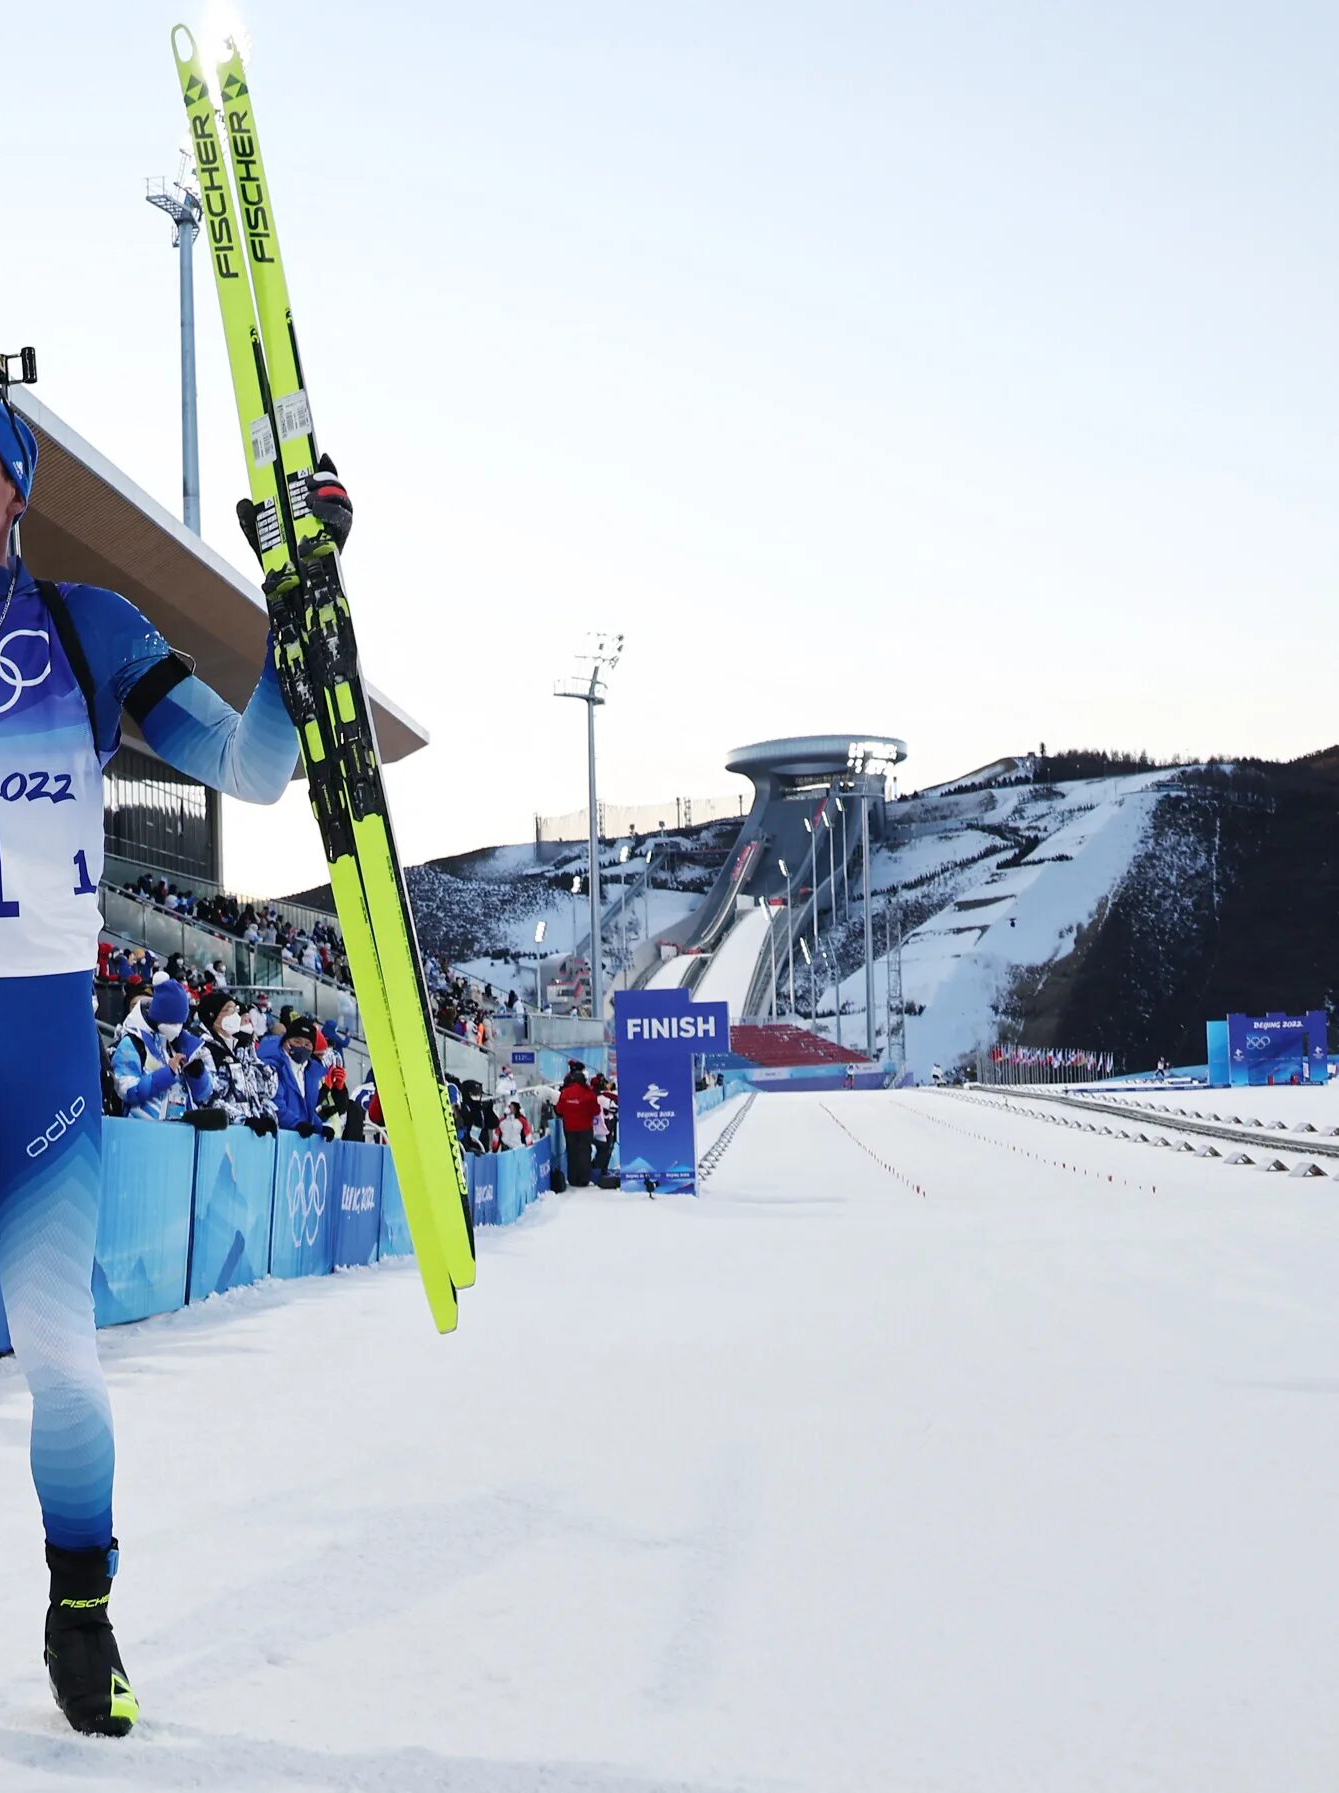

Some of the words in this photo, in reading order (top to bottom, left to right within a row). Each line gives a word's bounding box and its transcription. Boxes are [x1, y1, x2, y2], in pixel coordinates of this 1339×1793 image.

[192, 112, 239, 279] FISCHER
[228, 110, 275, 263] FISCHER
[627, 1016, 715, 1039] FINISH
[1253, 1021, 1281, 1030] BEIJING
[1282, 1020, 1304, 1028] 2022
[26, 1096, 86, 1158] odlo
[60, 1593, 110, 1608] FISCHE
